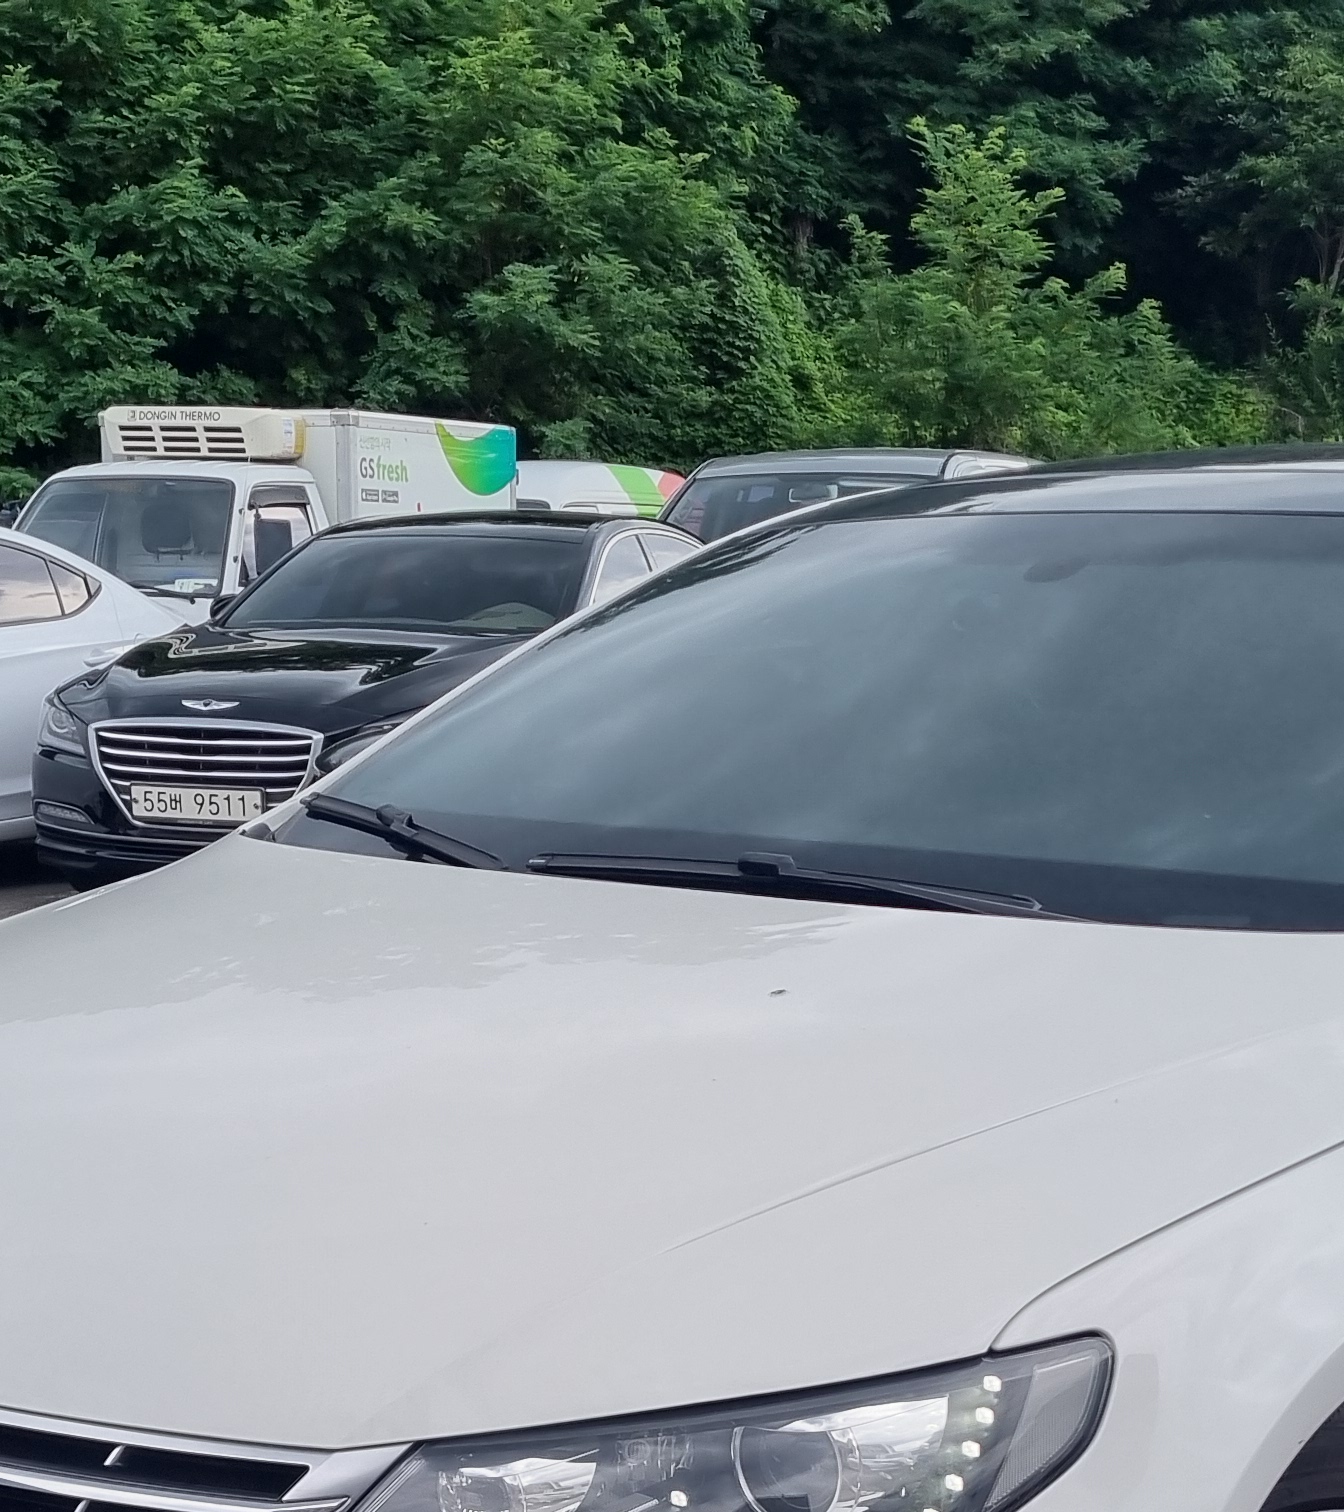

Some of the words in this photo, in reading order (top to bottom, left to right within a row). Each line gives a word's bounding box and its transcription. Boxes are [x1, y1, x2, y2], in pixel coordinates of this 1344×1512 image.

[138, 410, 177, 421] DONGIN
[180, 411, 221, 422] THERMO
[143, 790, 183, 813] 55버
[193, 793, 246, 817] 9511
